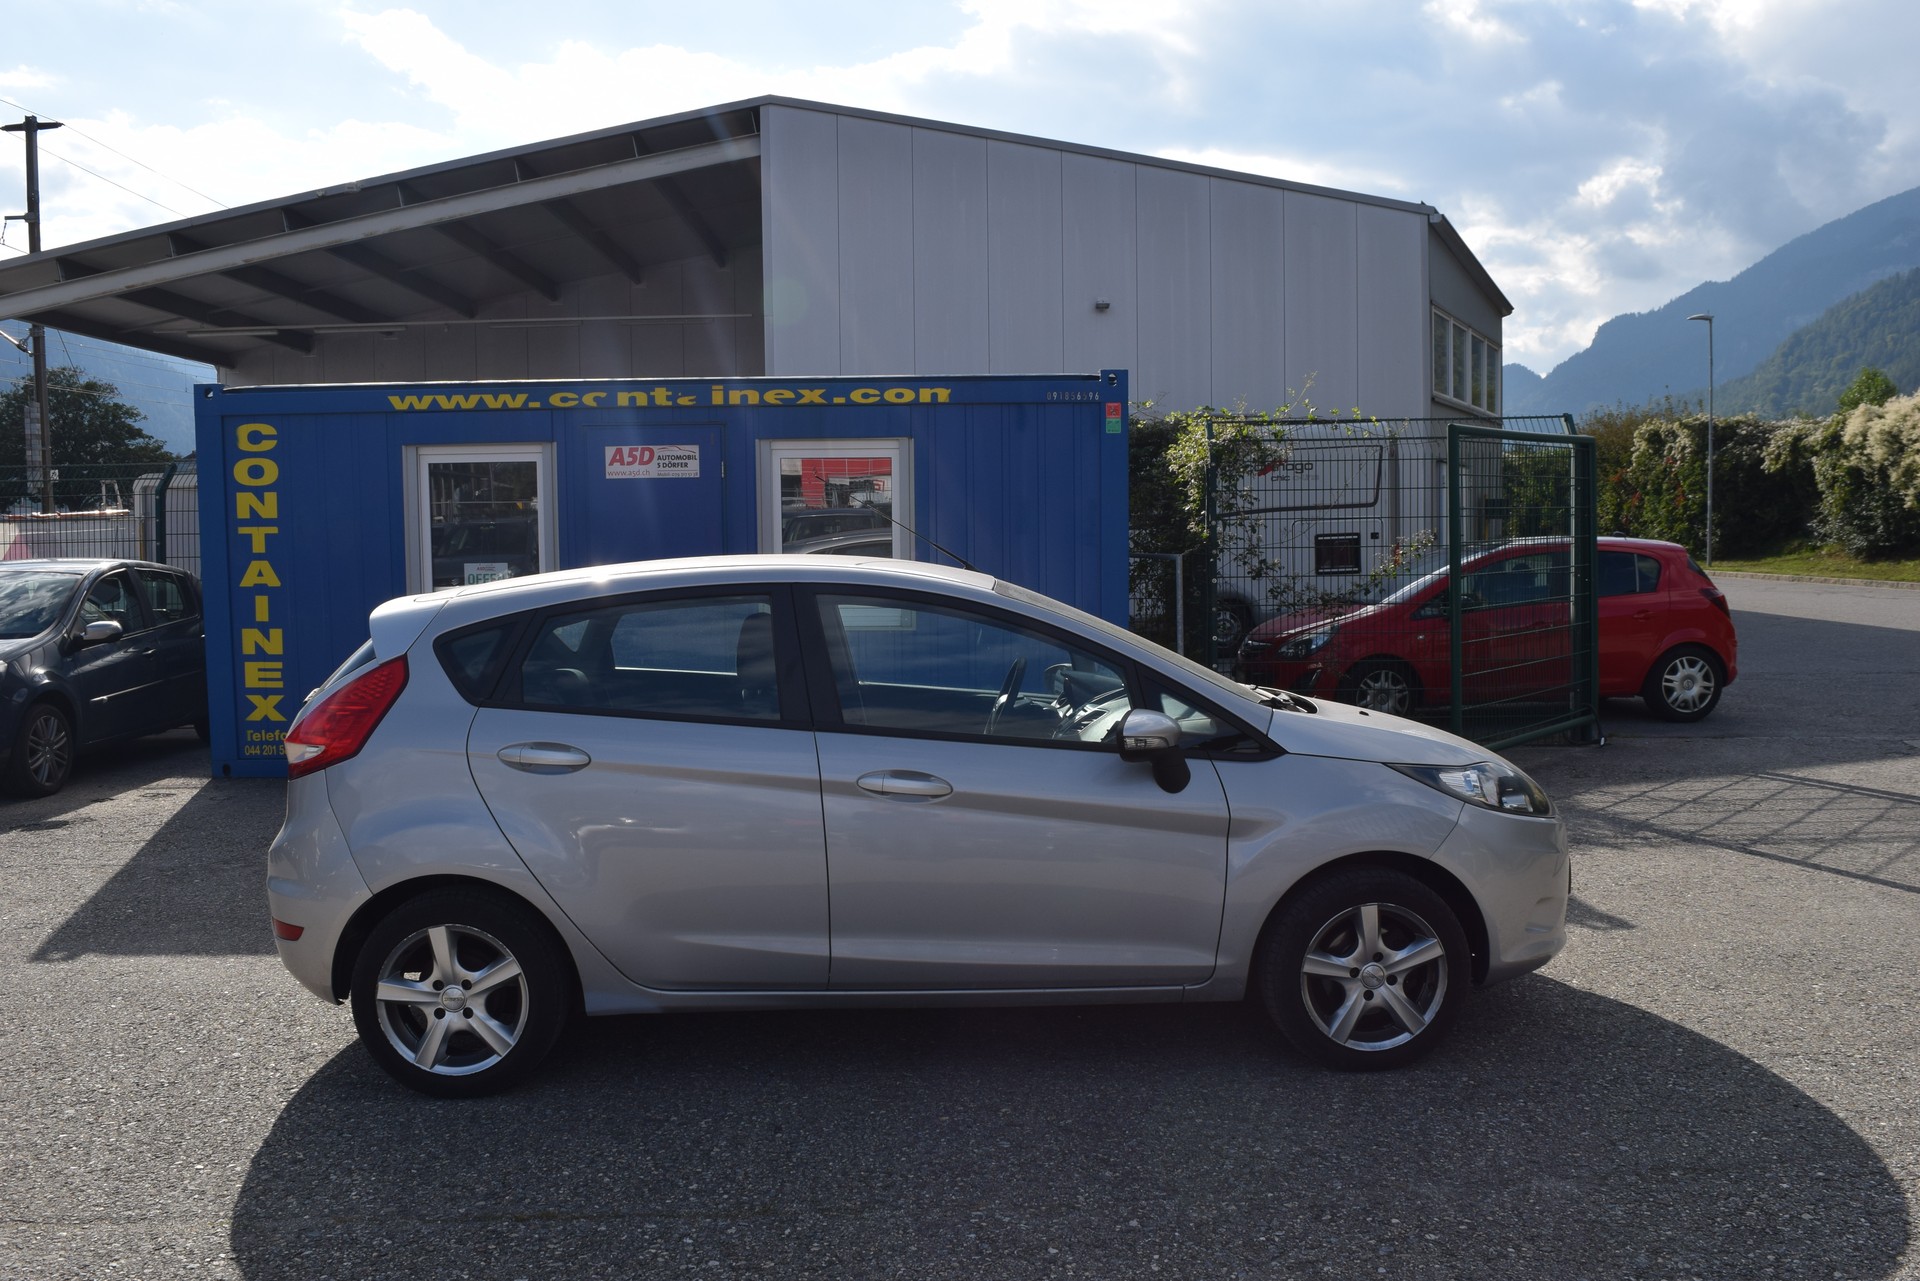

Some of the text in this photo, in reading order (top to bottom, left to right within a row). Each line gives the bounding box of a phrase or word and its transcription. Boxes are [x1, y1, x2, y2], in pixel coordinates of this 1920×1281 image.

[608, 446, 656, 467] A5D
[607, 469, 651, 478] www.a5d.ch
[233, 422, 288, 722] CONTAINEX
[246, 729, 288, 742] Telefo
[244, 745, 260, 756] 044
[262, 745, 277, 756] 201
